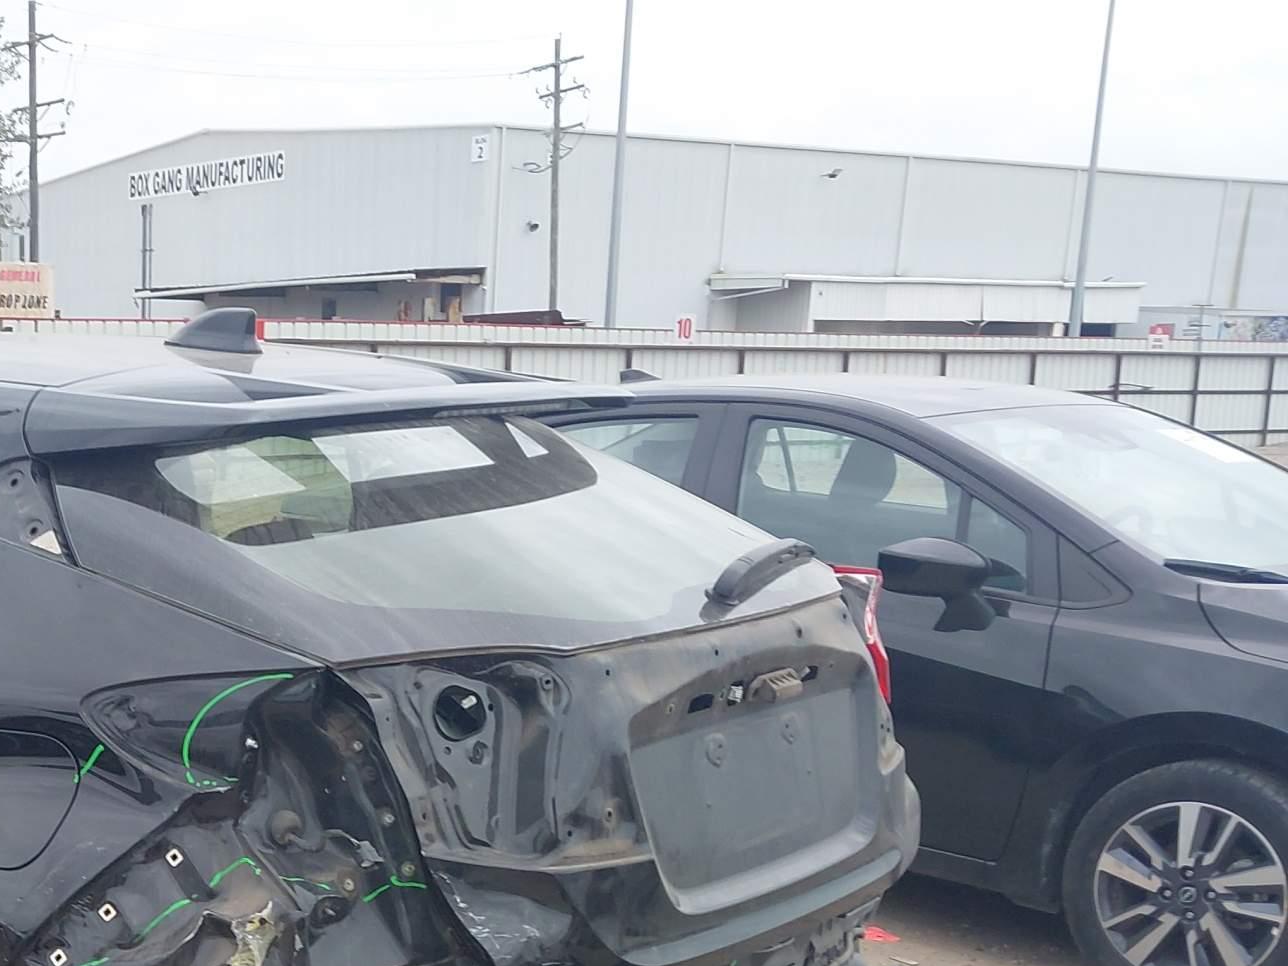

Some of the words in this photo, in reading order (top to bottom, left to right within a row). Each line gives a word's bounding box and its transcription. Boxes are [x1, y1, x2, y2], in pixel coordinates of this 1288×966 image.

[129, 169, 151, 198] BOX
[153, 168, 183, 194] GANG
[185, 152, 285, 190] MANUFACTURING
[677, 318, 692, 339] 10
